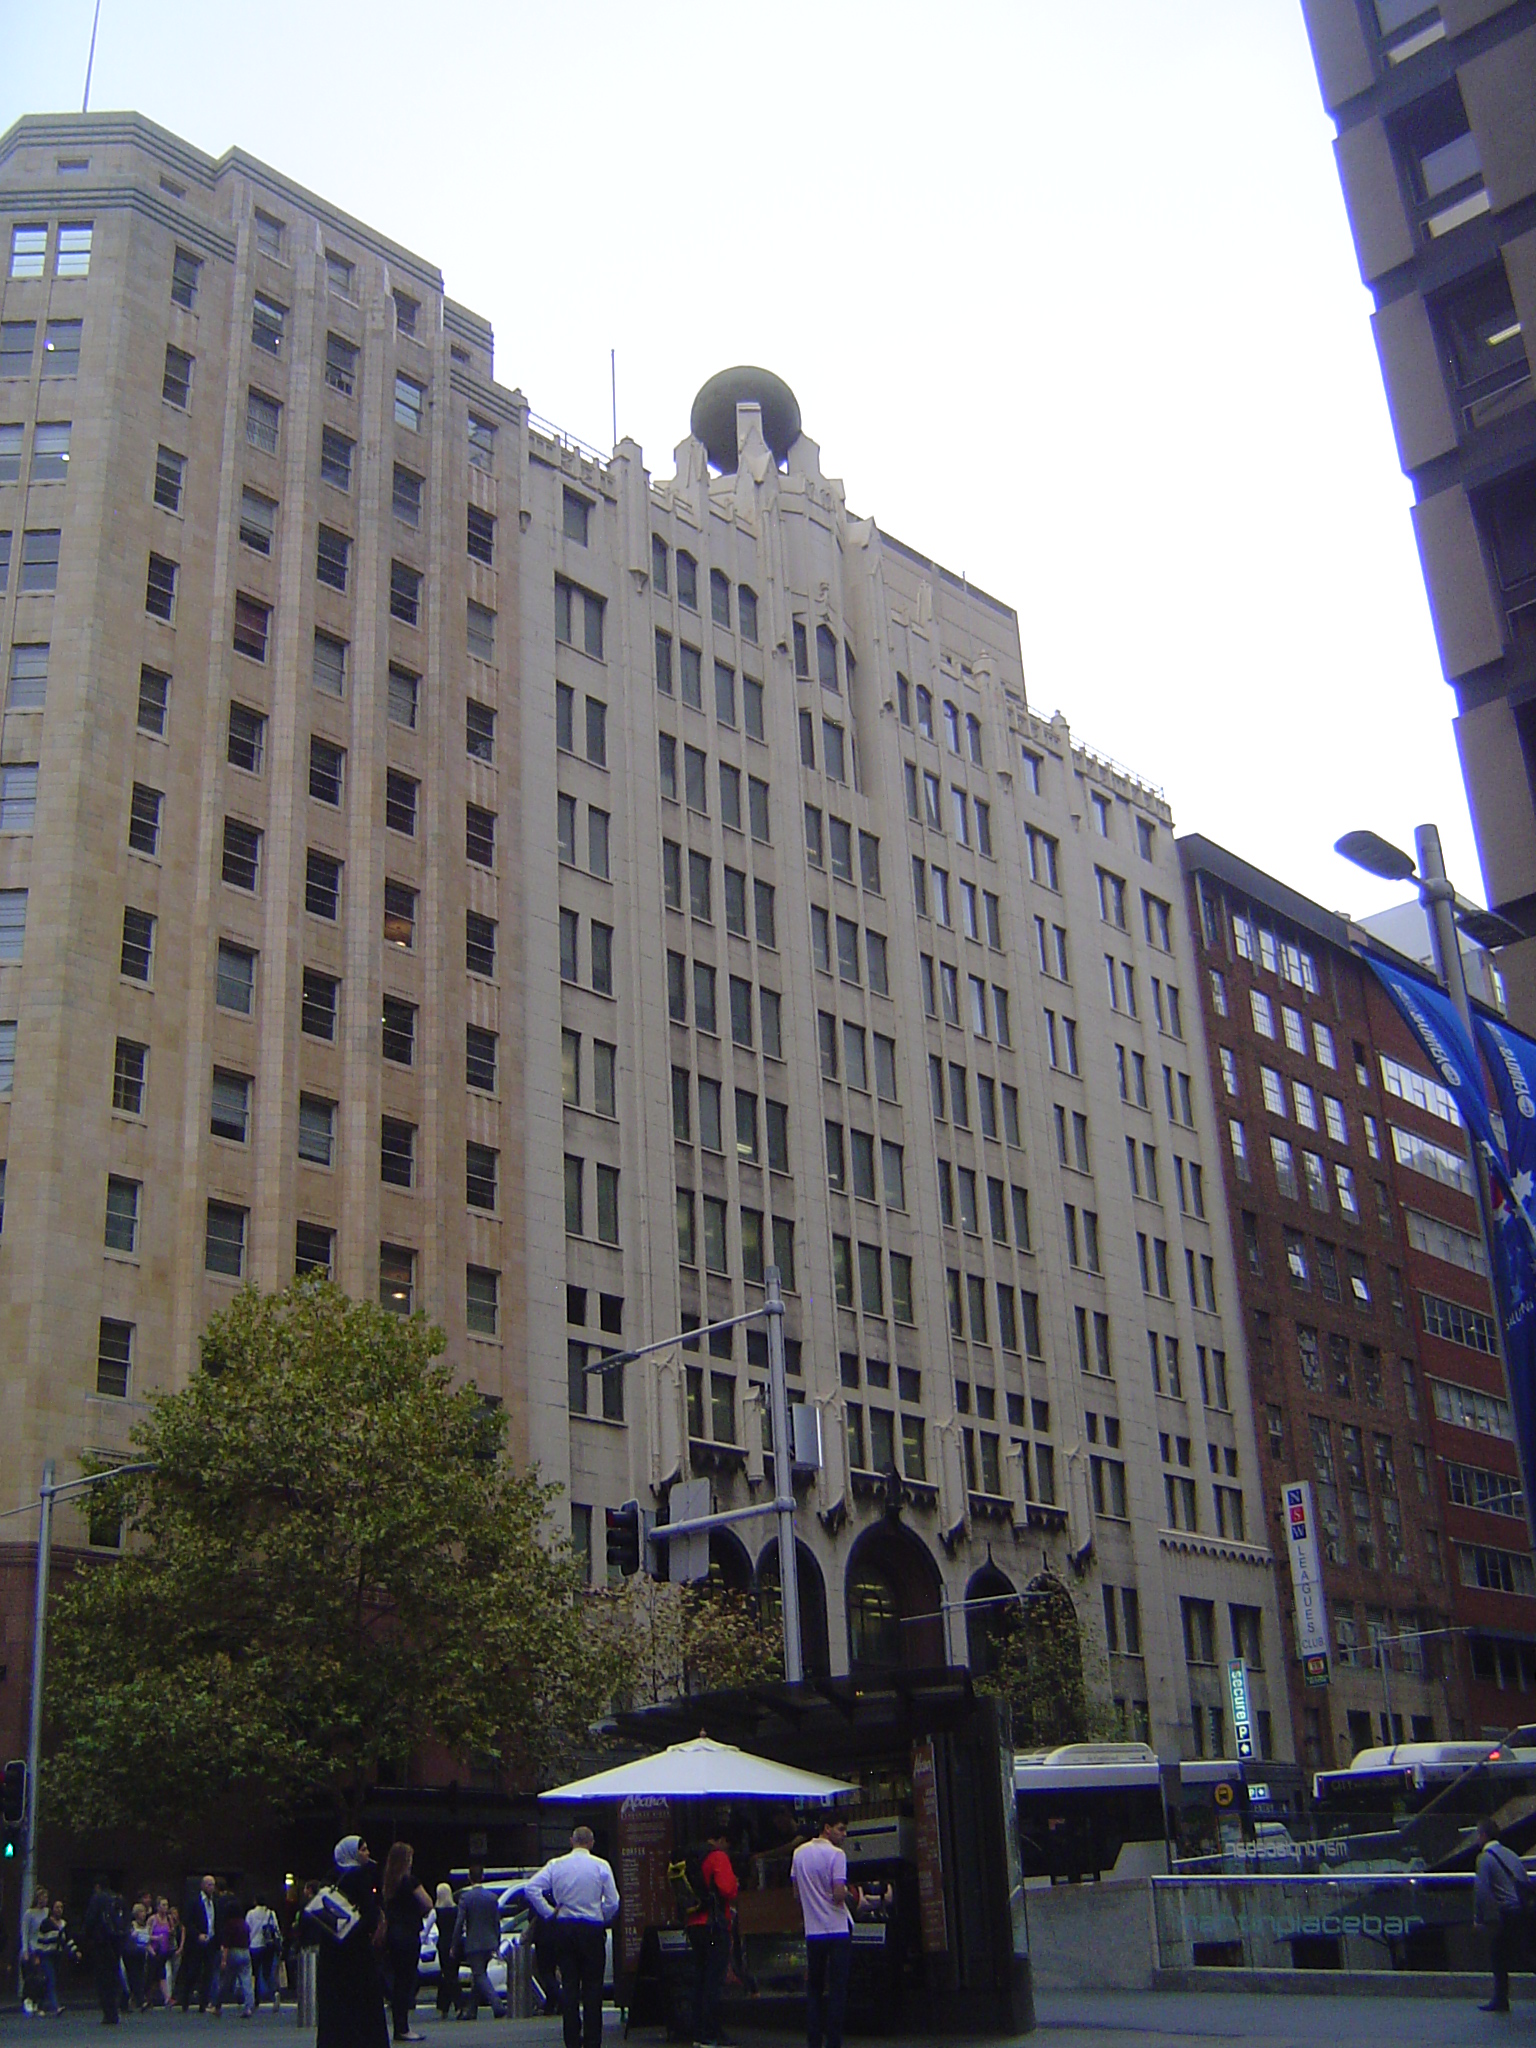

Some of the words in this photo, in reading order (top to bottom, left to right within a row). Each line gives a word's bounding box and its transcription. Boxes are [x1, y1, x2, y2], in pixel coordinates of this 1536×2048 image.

[1297, 1545, 1315, 1633] LEAGUES
[1301, 1636, 1324, 1649] CLUB
[1231, 1670, 1247, 1720] secure
